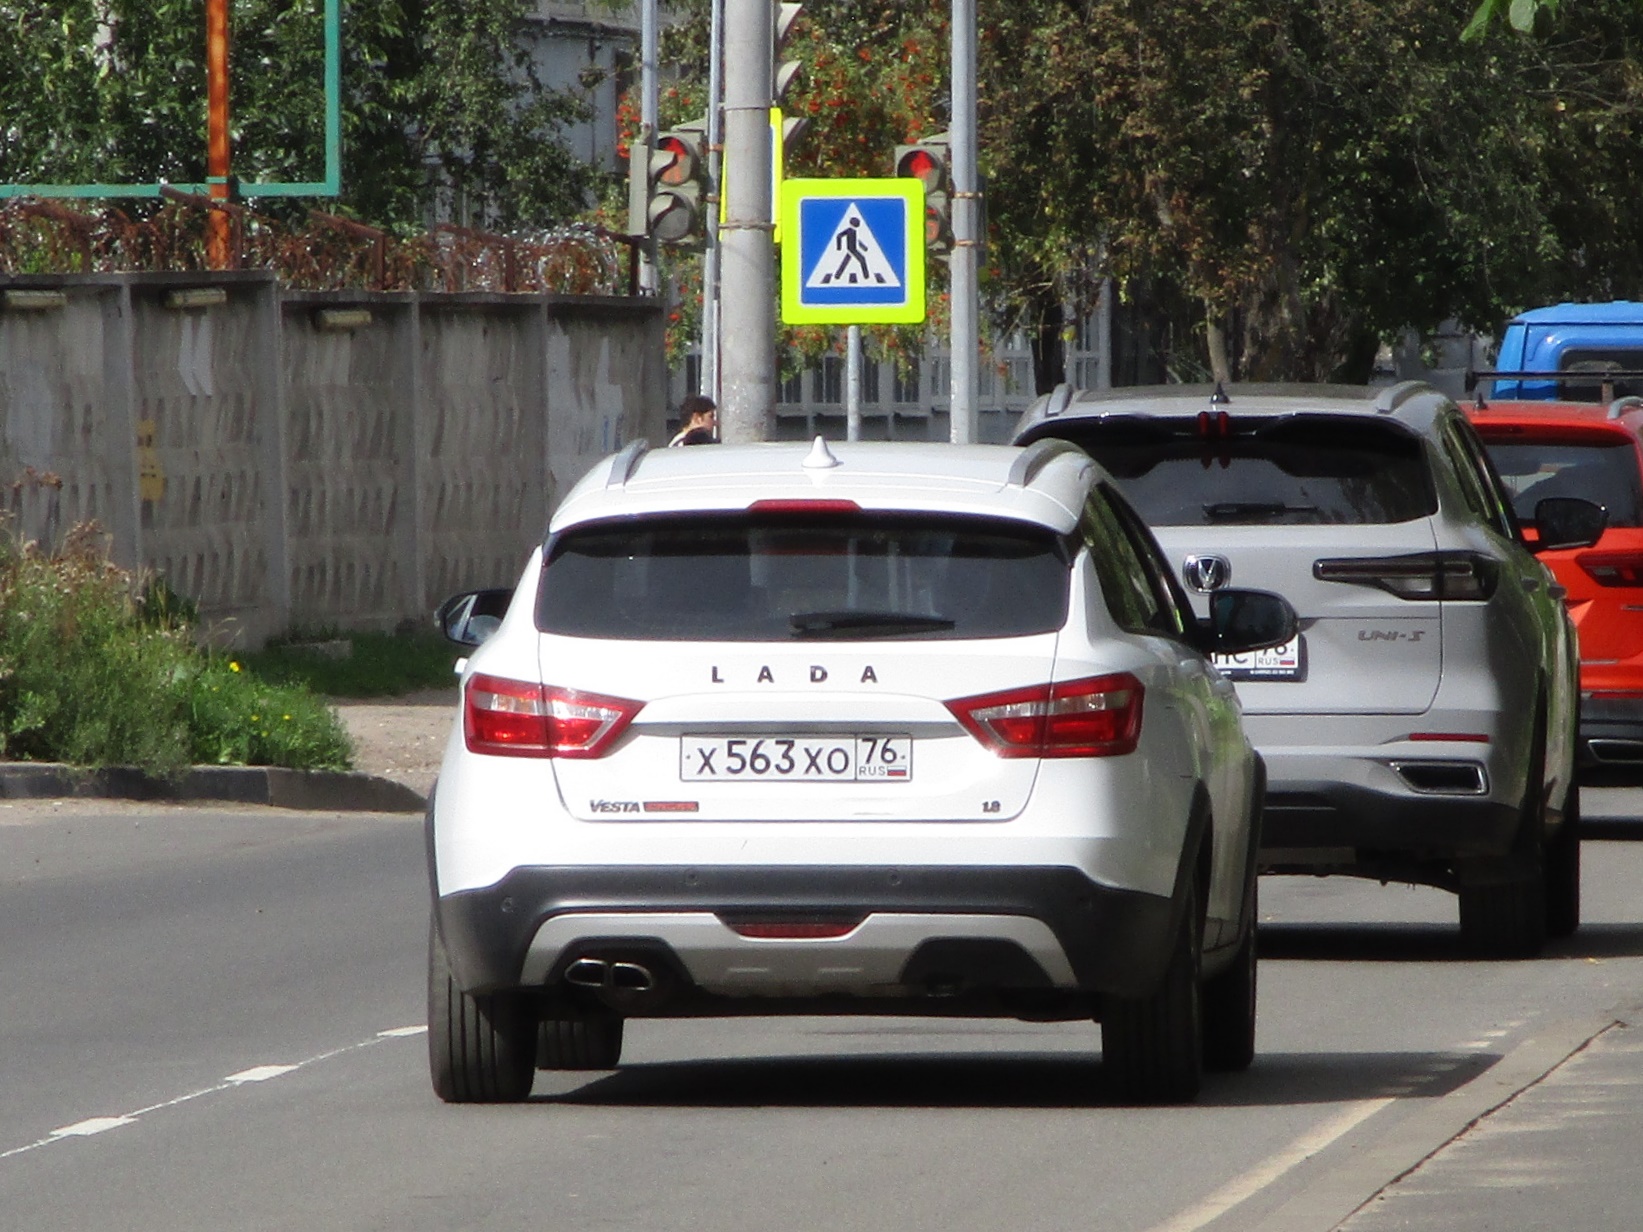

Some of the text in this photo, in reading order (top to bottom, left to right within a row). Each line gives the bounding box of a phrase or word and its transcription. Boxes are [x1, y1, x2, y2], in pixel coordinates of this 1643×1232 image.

[711, 665, 878, 683] LADA
[862, 738, 897, 765] 76
[858, 765, 886, 776] RUS
[589, 799, 640, 813] VESTA
